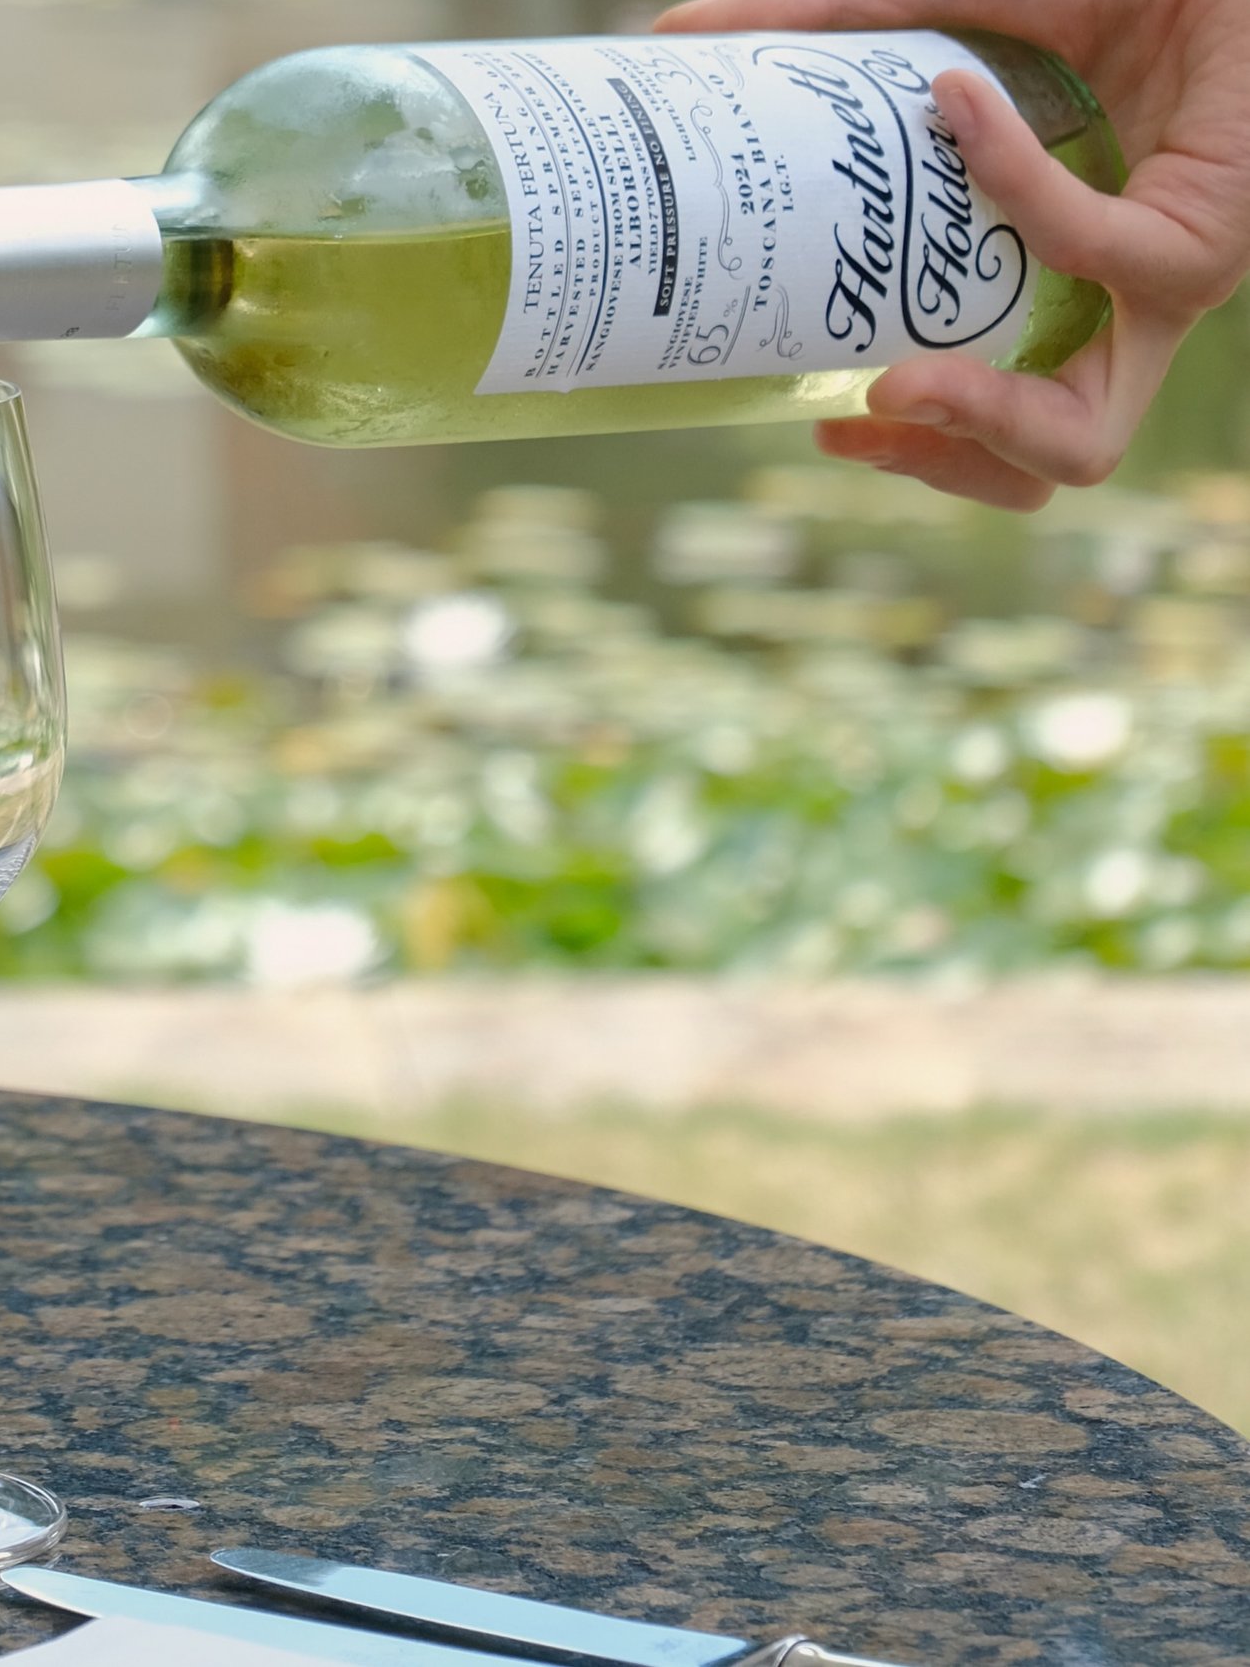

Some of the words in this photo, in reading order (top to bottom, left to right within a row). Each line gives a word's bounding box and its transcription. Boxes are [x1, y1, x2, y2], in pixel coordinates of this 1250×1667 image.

[483, 91, 538, 197] FERTUNA
[524, 85, 583, 218] SEPTEMBER
[556, 106, 585, 155] ITALY
[584, 117, 618, 186] SINGLE
[619, 84, 654, 134] FINING
[629, 131, 646, 162] PER
[650, 140, 666, 165] NO
[662, 98, 698, 161] LIGHTLY
[708, 74, 767, 163] BIANCO
[517, 104, 561, 215] SPRING
[583, 166, 594, 189] OF
[598, 114, 642, 269] ALBORELLI
[730, 152, 755, 215] 2024
[774, 154, 794, 212] I.G.T.
[589, 200, 601, 297] PRODUCT
[610, 191, 624, 248] FROM
[648, 224, 659, 275] YIELD
[660, 172, 677, 257] PRESSURE
[753, 178, 776, 311] TOSCANA
[772, 62, 894, 353] Hartnett
[916, 124, 972, 327] Holder
[523, 204, 545, 314] TENUTA
[659, 265, 675, 307] SOFT
[668, 299, 700, 368] VINIFIED
[694, 236, 708, 296] WHITE
[524, 239, 564, 378] BOTTLED
[547, 238, 586, 376] HARVESTED
[585, 254, 624, 371] SANGIOVESE
[657, 276, 693, 370] SANGIOVESE
